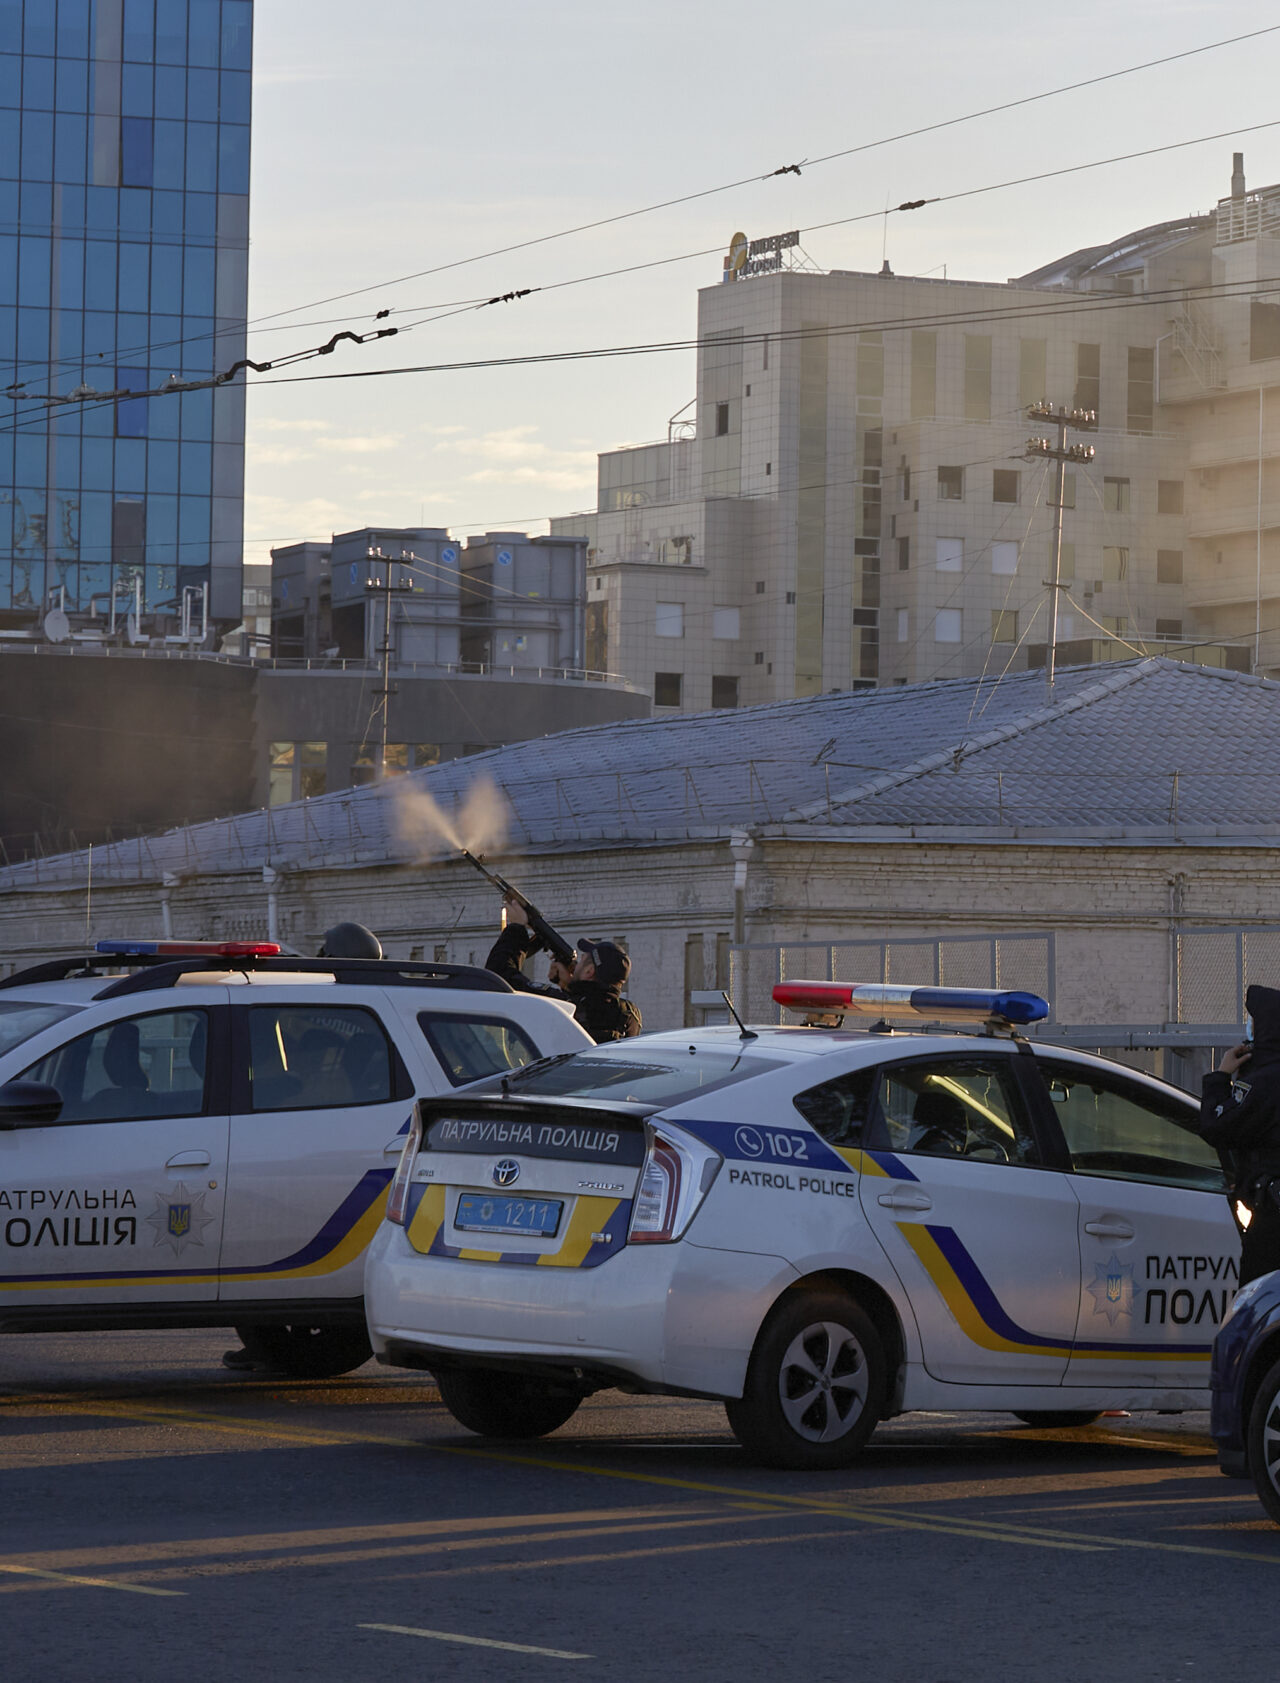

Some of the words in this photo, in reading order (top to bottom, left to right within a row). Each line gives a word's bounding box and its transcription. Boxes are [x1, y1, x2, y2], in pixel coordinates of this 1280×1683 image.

[439, 1120, 533, 1144] ПАТРУЛЬНА
[538, 1126, 620, 1153] ПОЛІЦІЯ
[766, 1132, 809, 1161] 102
[729, 1169, 796, 1191] PATROL
[799, 1178, 855, 1198] POLICE
[504, 1202, 549, 1227] 1211
[5, 1216, 137, 1247] ОЛІЦІЯ
[1144, 1289, 1236, 1325] ПОЛІ
